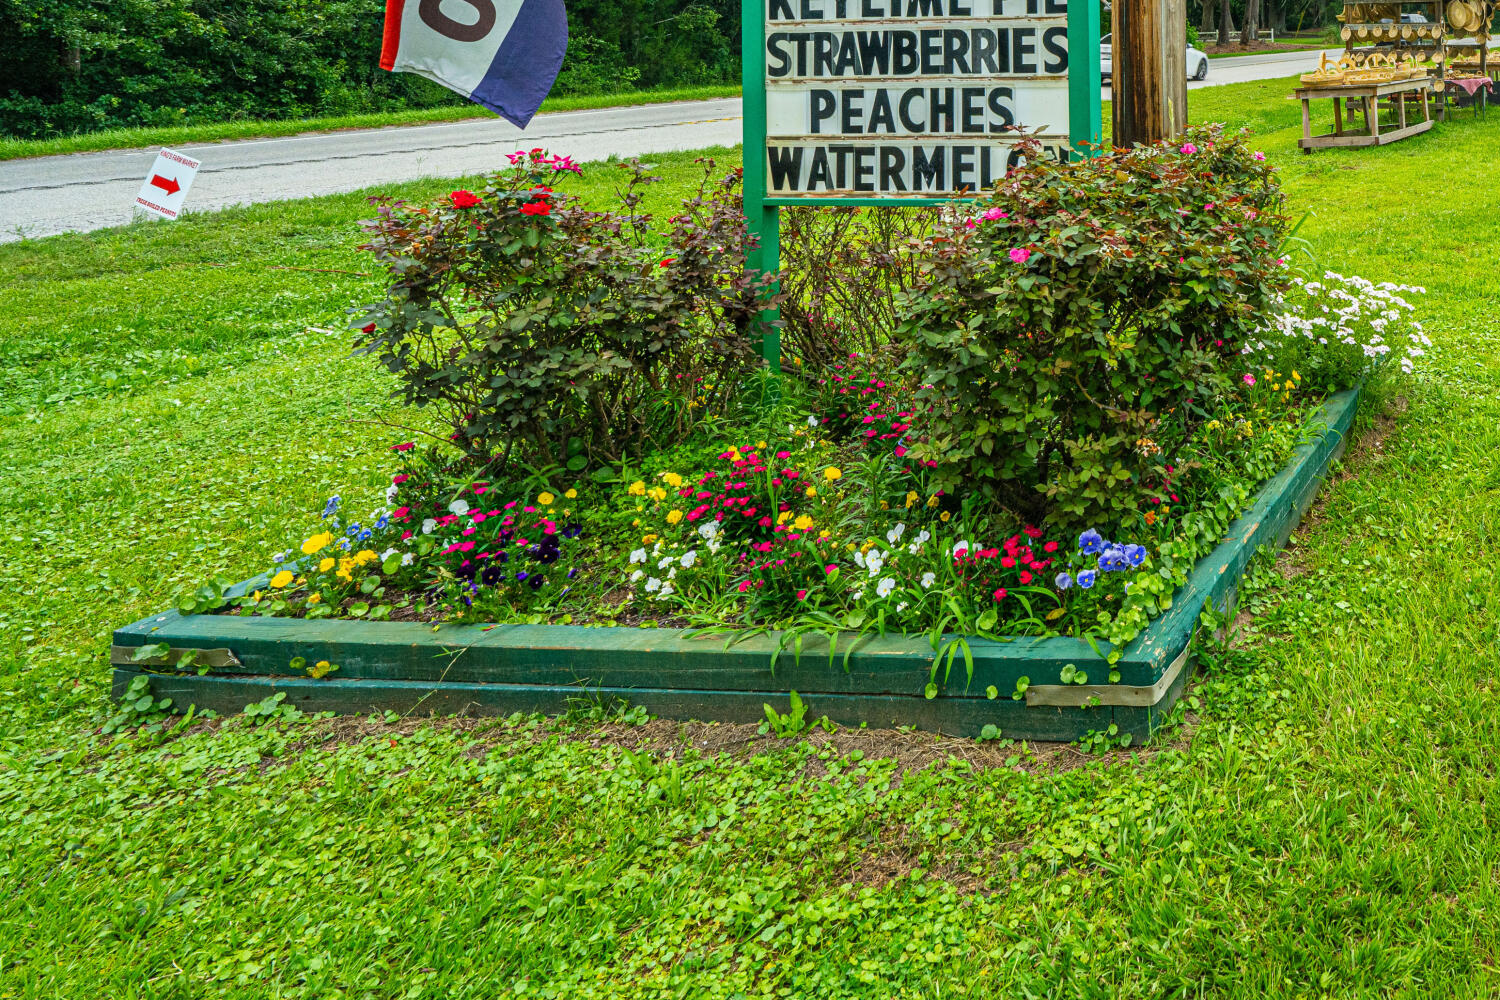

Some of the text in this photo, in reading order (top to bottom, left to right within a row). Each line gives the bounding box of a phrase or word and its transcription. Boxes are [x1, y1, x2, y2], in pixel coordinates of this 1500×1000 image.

[766, 26, 1069, 78] STRAWBERRIES
[810, 86, 1015, 134] PEACHES
[182, 159, 199, 169] MARKET
